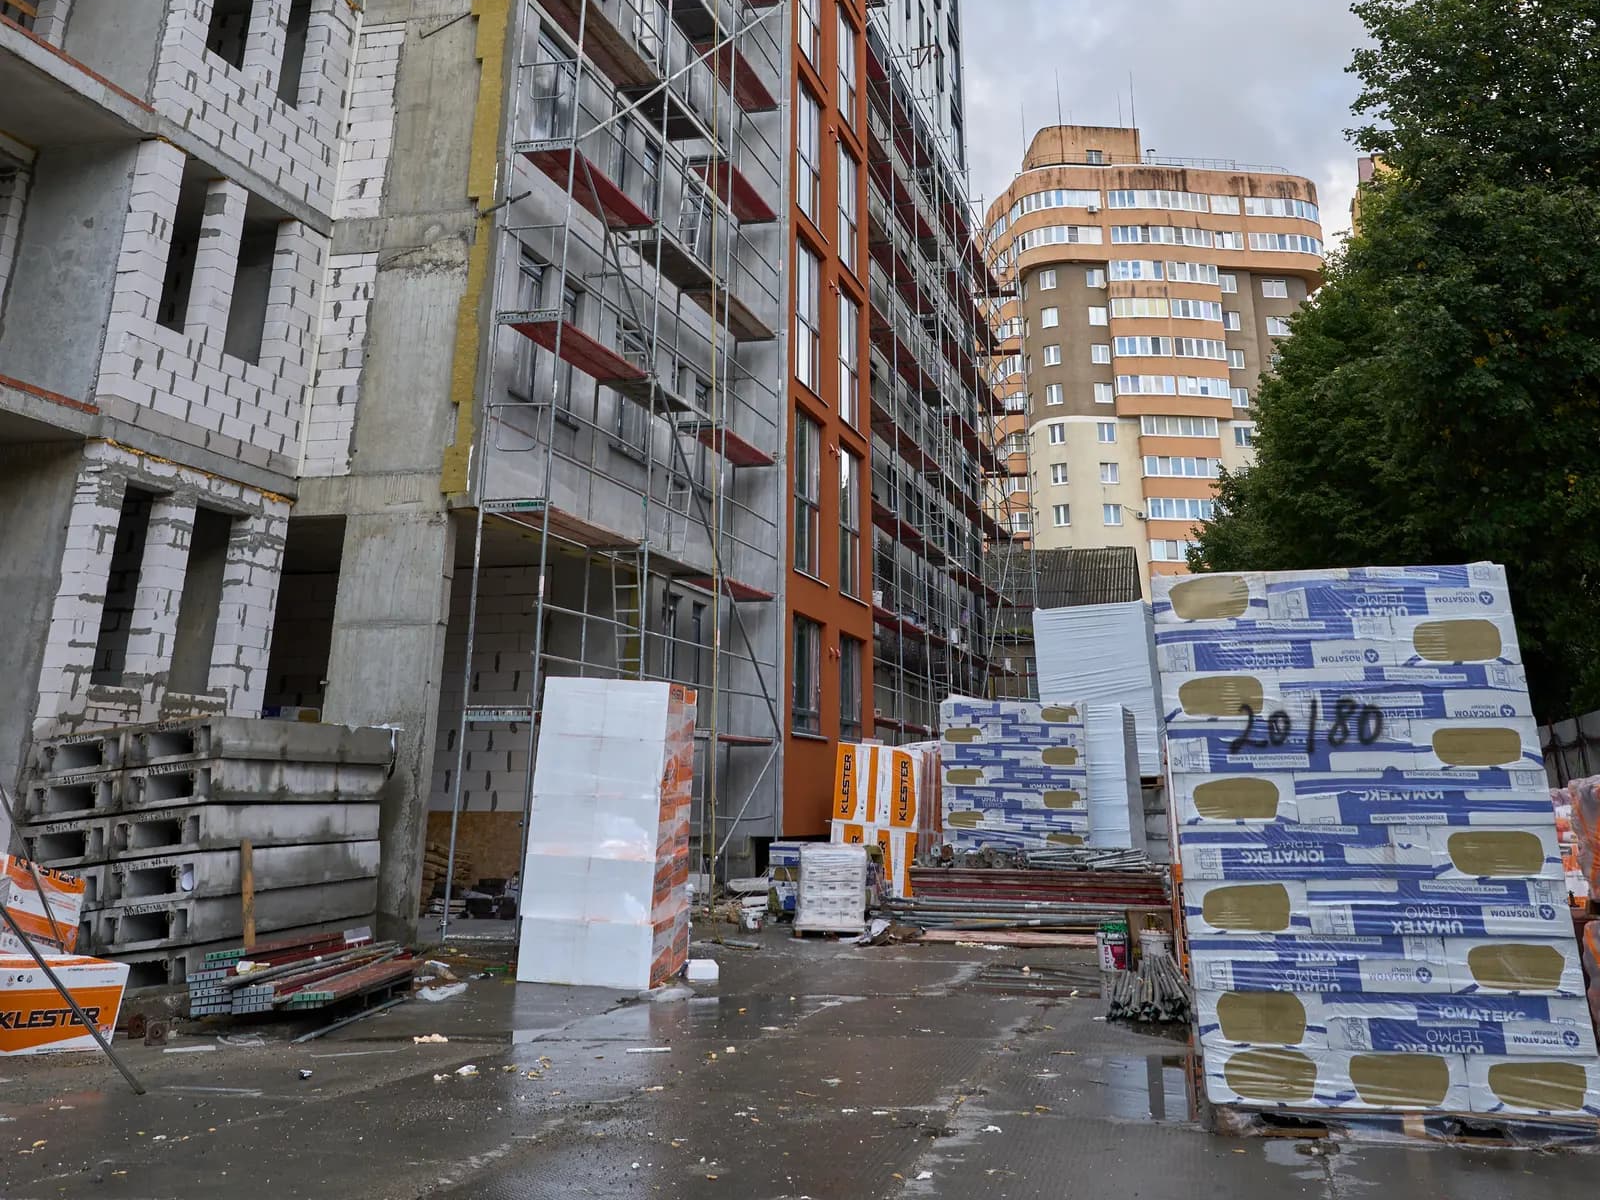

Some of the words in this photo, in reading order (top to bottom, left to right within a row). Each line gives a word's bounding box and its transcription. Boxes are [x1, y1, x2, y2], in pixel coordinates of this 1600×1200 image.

[1434, 596, 1476, 604] ROSATOM
[1229, 696, 1383, 754] 20/80
[840, 754, 852, 814] KLESTER
[898, 760, 909, 821] KLESTER
[1358, 790, 1444, 801] ЮМАТЕКС
[1241, 850, 1324, 864] ЮМАТЕКС
[1404, 906, 1461, 918] TERMO
[1490, 910, 1536, 918] ROSATOM
[1391, 920, 1464, 934] UMATEX
[1285, 969, 1340, 982] TERMO
[0, 1007, 100, 1030] KLESTER
[1426, 1029, 1481, 1044] ТЕРМО
[1512, 1036, 1559, 1045] РОСАТОМ
